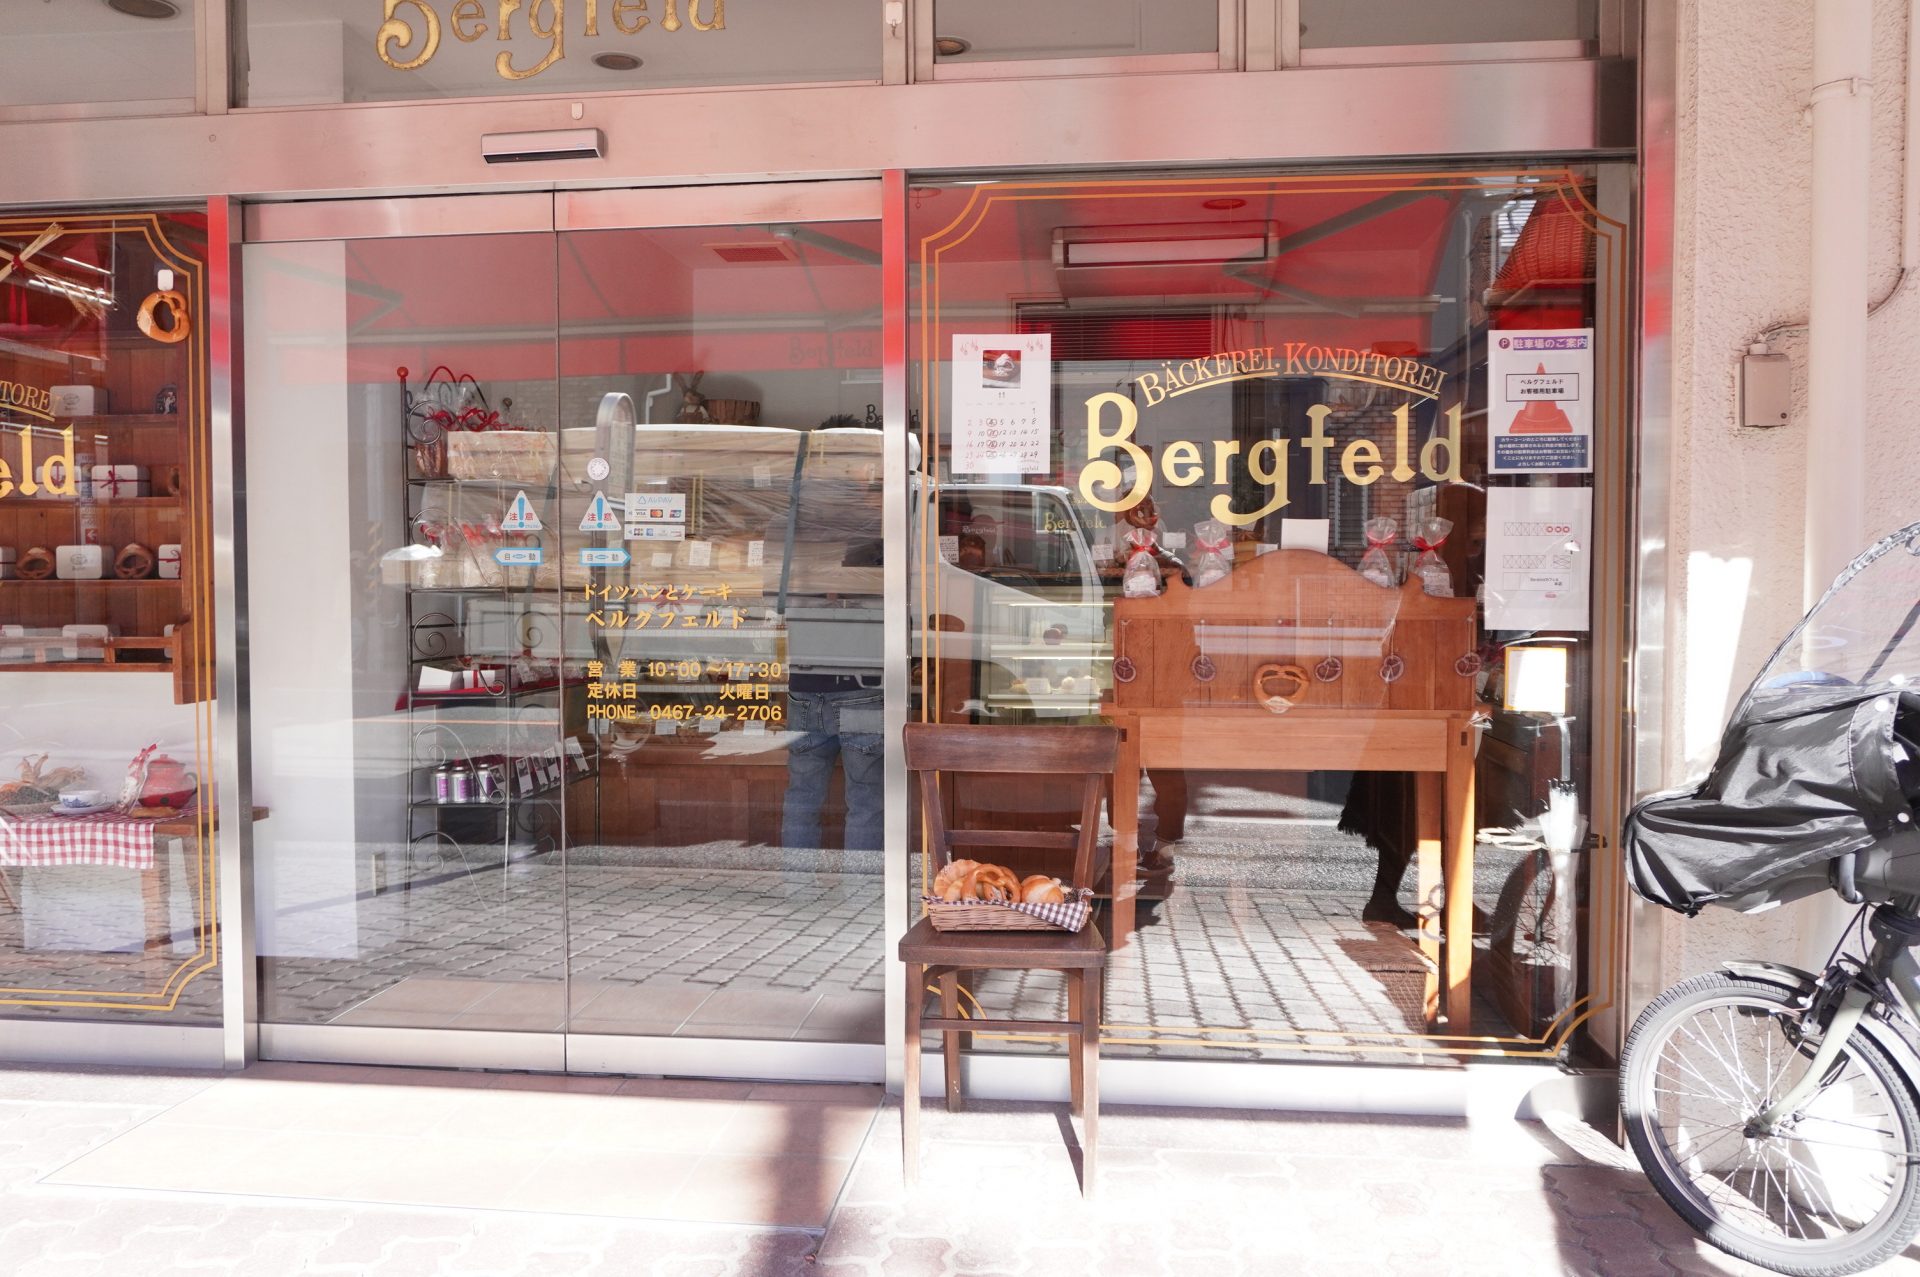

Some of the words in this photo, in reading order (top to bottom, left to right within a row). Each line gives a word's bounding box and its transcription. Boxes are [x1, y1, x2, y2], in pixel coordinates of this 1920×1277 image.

[1513, 337, 1588, 349] 駐車場のご案内
[1078, 392, 1465, 526] Bergfeld
[509, 512, 533, 521] 注意
[587, 512, 612, 521] 注意
[584, 583, 733, 601] ドイツパンとケーキ
[585, 608, 749, 630] ベルグフェルド
[587, 683, 637, 700] 定休日
[719, 683, 769, 701] 火曜日
[587, 704, 636, 720] PHONE
[650, 705, 782, 721] 0467-24-2706
